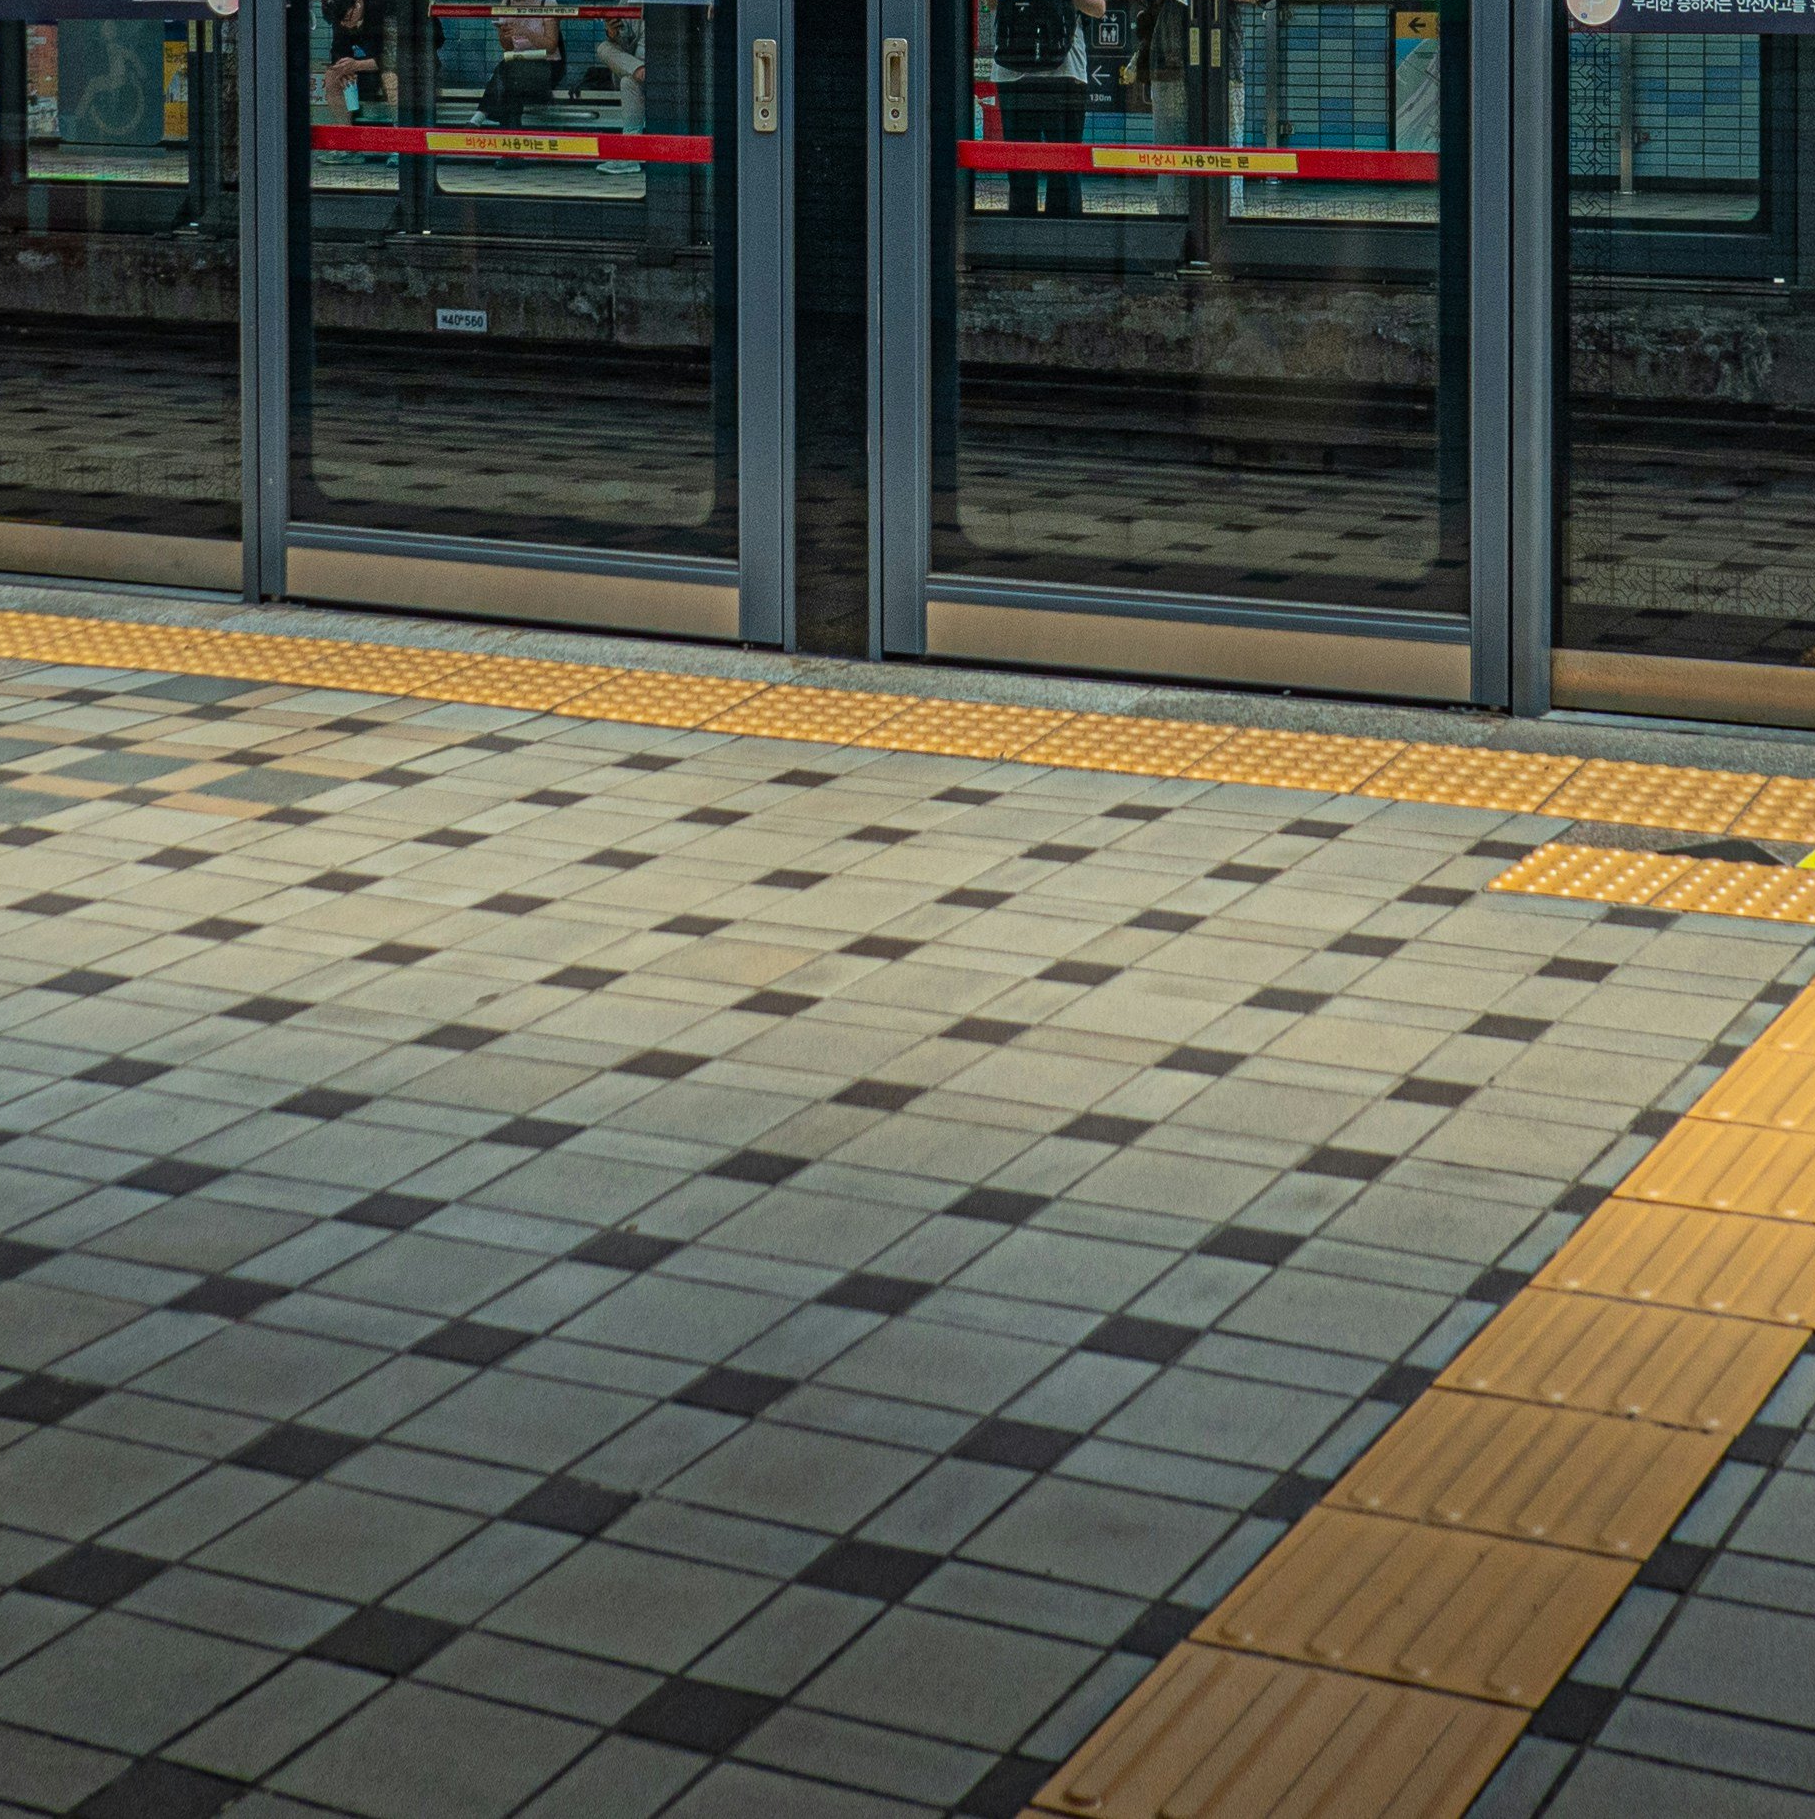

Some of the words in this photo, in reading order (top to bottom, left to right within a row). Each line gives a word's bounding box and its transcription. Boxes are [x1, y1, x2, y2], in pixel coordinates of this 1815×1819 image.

[1089, 93, 1112, 103] 130m
[465, 136, 498, 149] 비상시
[501, 138, 544, 150] 사용하는
[548, 139, 559, 151] 문
[1138, 152, 1176, 166] 비상시
[1181, 154, 1232, 168] 사용하는
[1237, 156, 1250, 168] 문
